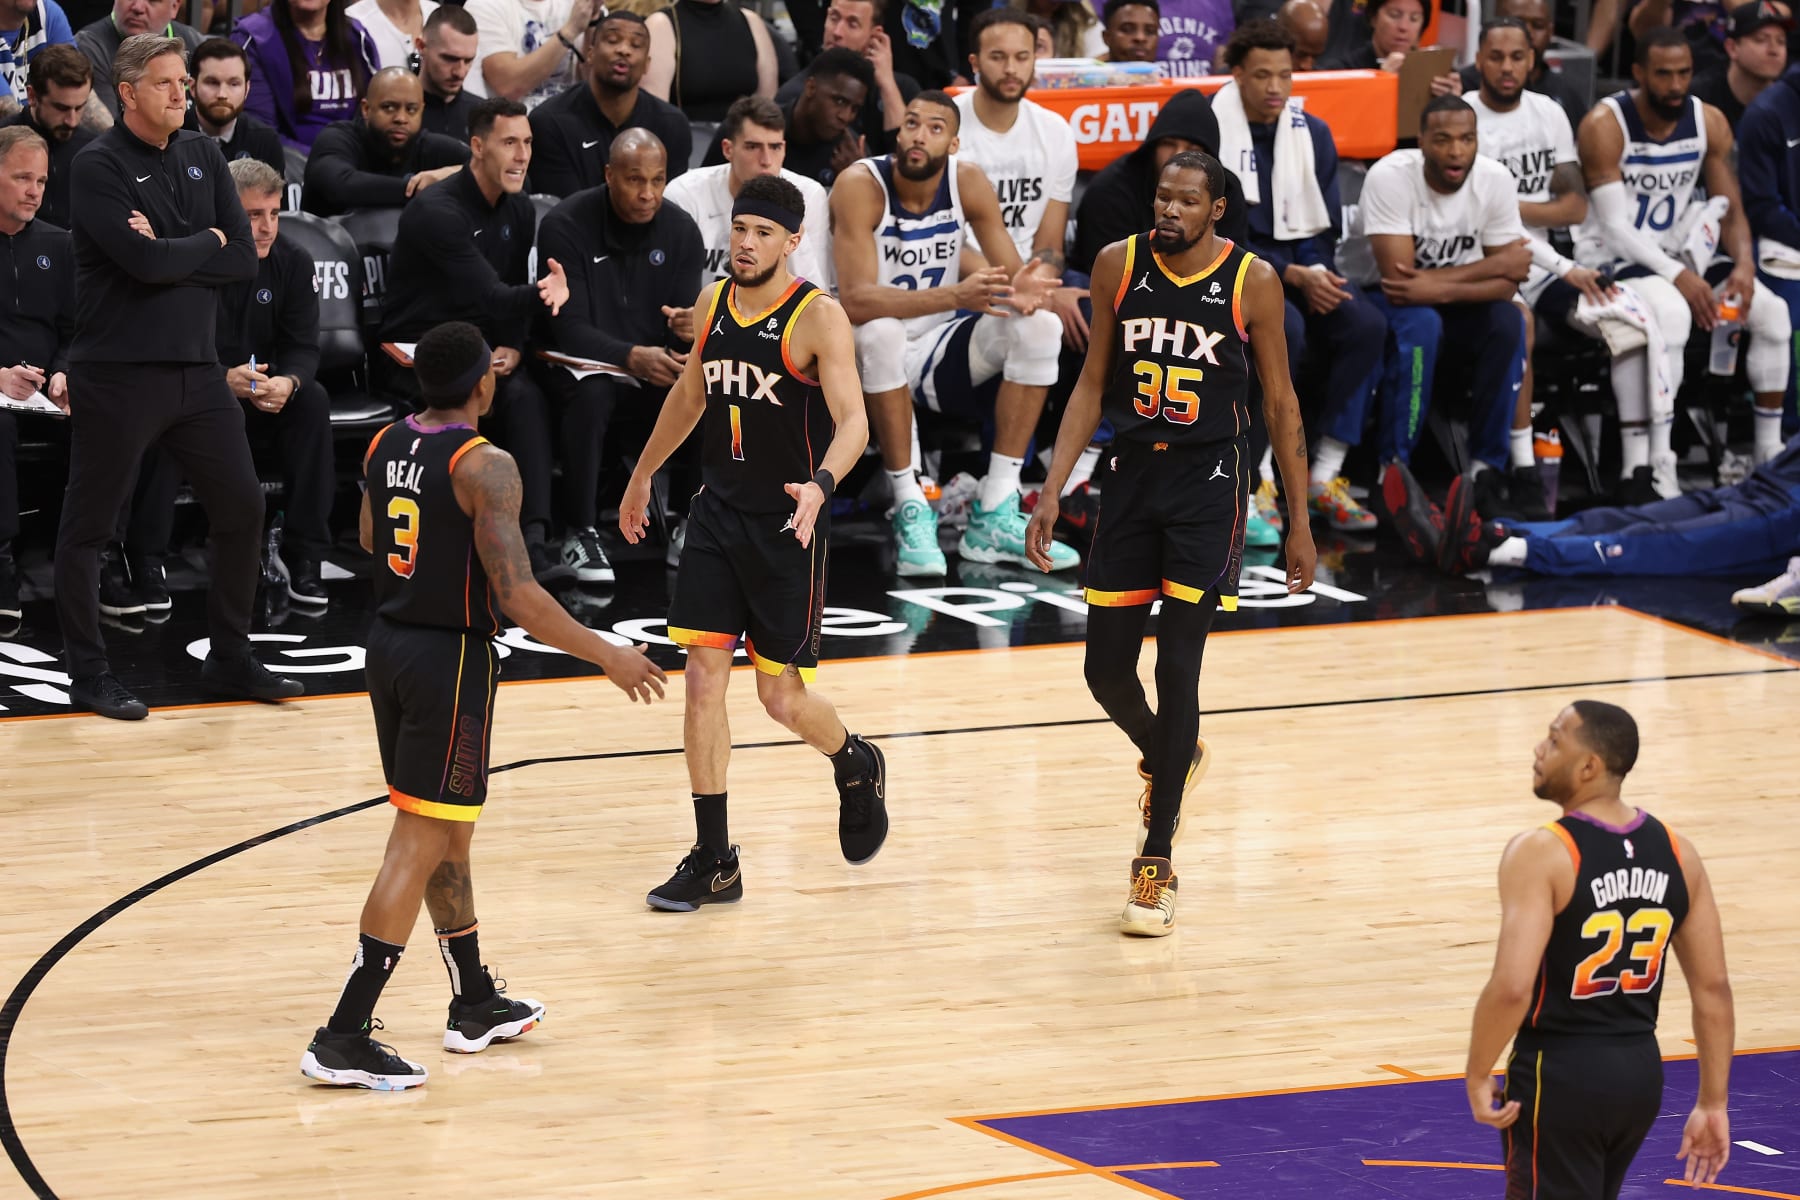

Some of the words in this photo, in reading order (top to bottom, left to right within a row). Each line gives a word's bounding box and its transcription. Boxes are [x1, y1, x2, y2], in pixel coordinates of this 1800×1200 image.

[1158, 16, 1218, 44] OENIX
[1633, 193, 1676, 231] 10
[1201, 295, 1226, 305] PayPal
[757, 330, 780, 341] PayPal
[1121, 317, 1226, 366] PHX
[702, 359, 783, 407] PHX
[1133, 359, 1204, 425] 35
[728, 404, 745, 461] 1
[386, 459, 424, 495] BEAL
[387, 495, 420, 580] 3
[1590, 866, 1669, 909] GORDON
[1570, 908, 1674, 1000] 23
